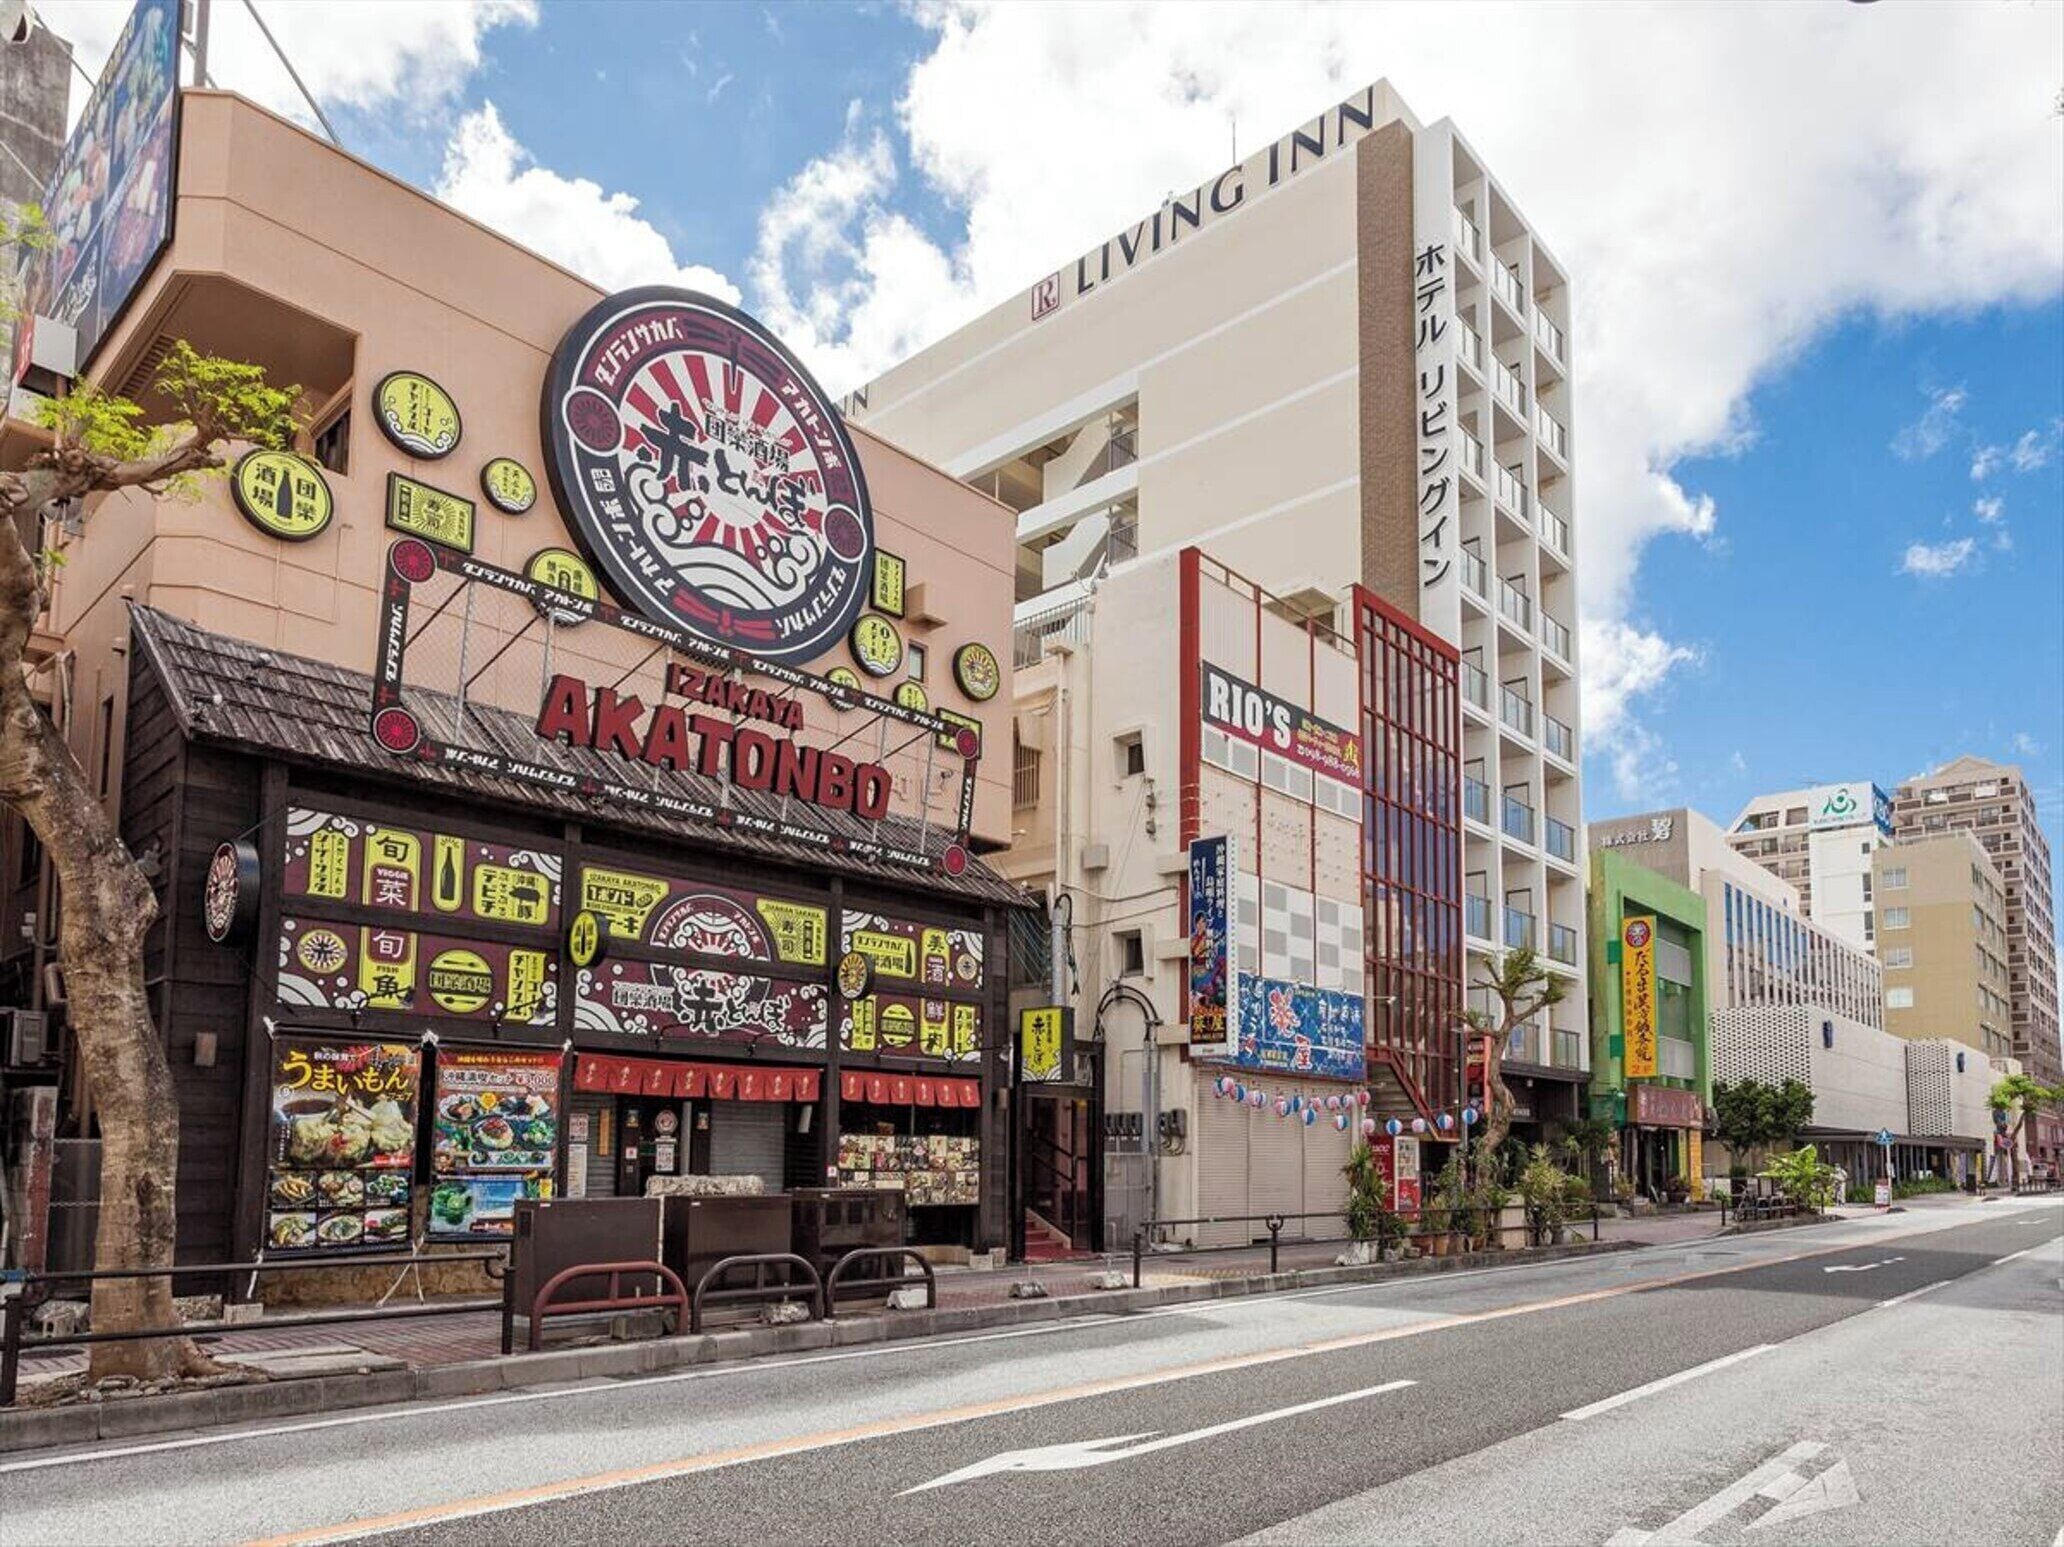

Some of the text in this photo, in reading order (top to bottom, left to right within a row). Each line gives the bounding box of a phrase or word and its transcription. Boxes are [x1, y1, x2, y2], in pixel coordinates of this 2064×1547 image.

[1077, 85, 1374, 295] LIVING INN
[781, 378, 841, 469] アカトンボ
[1415, 244, 1451, 588] ホテル リビングイン
[667, 663, 803, 731] IZAKAYA
[1209, 673, 1291, 749] RIO'S
[536, 674, 893, 820] AKATONBO
[376, 835, 409, 863] 旬
[375, 879, 408, 906] 菜
[481, 868, 497, 913] テビチ
[589, 873, 621, 886] IZAKAYA
[372, 930, 404, 958] 旬
[927, 935, 945, 952] 美
[927, 963, 945, 983] 酒
[282, 1049, 408, 1096] うまいもん
